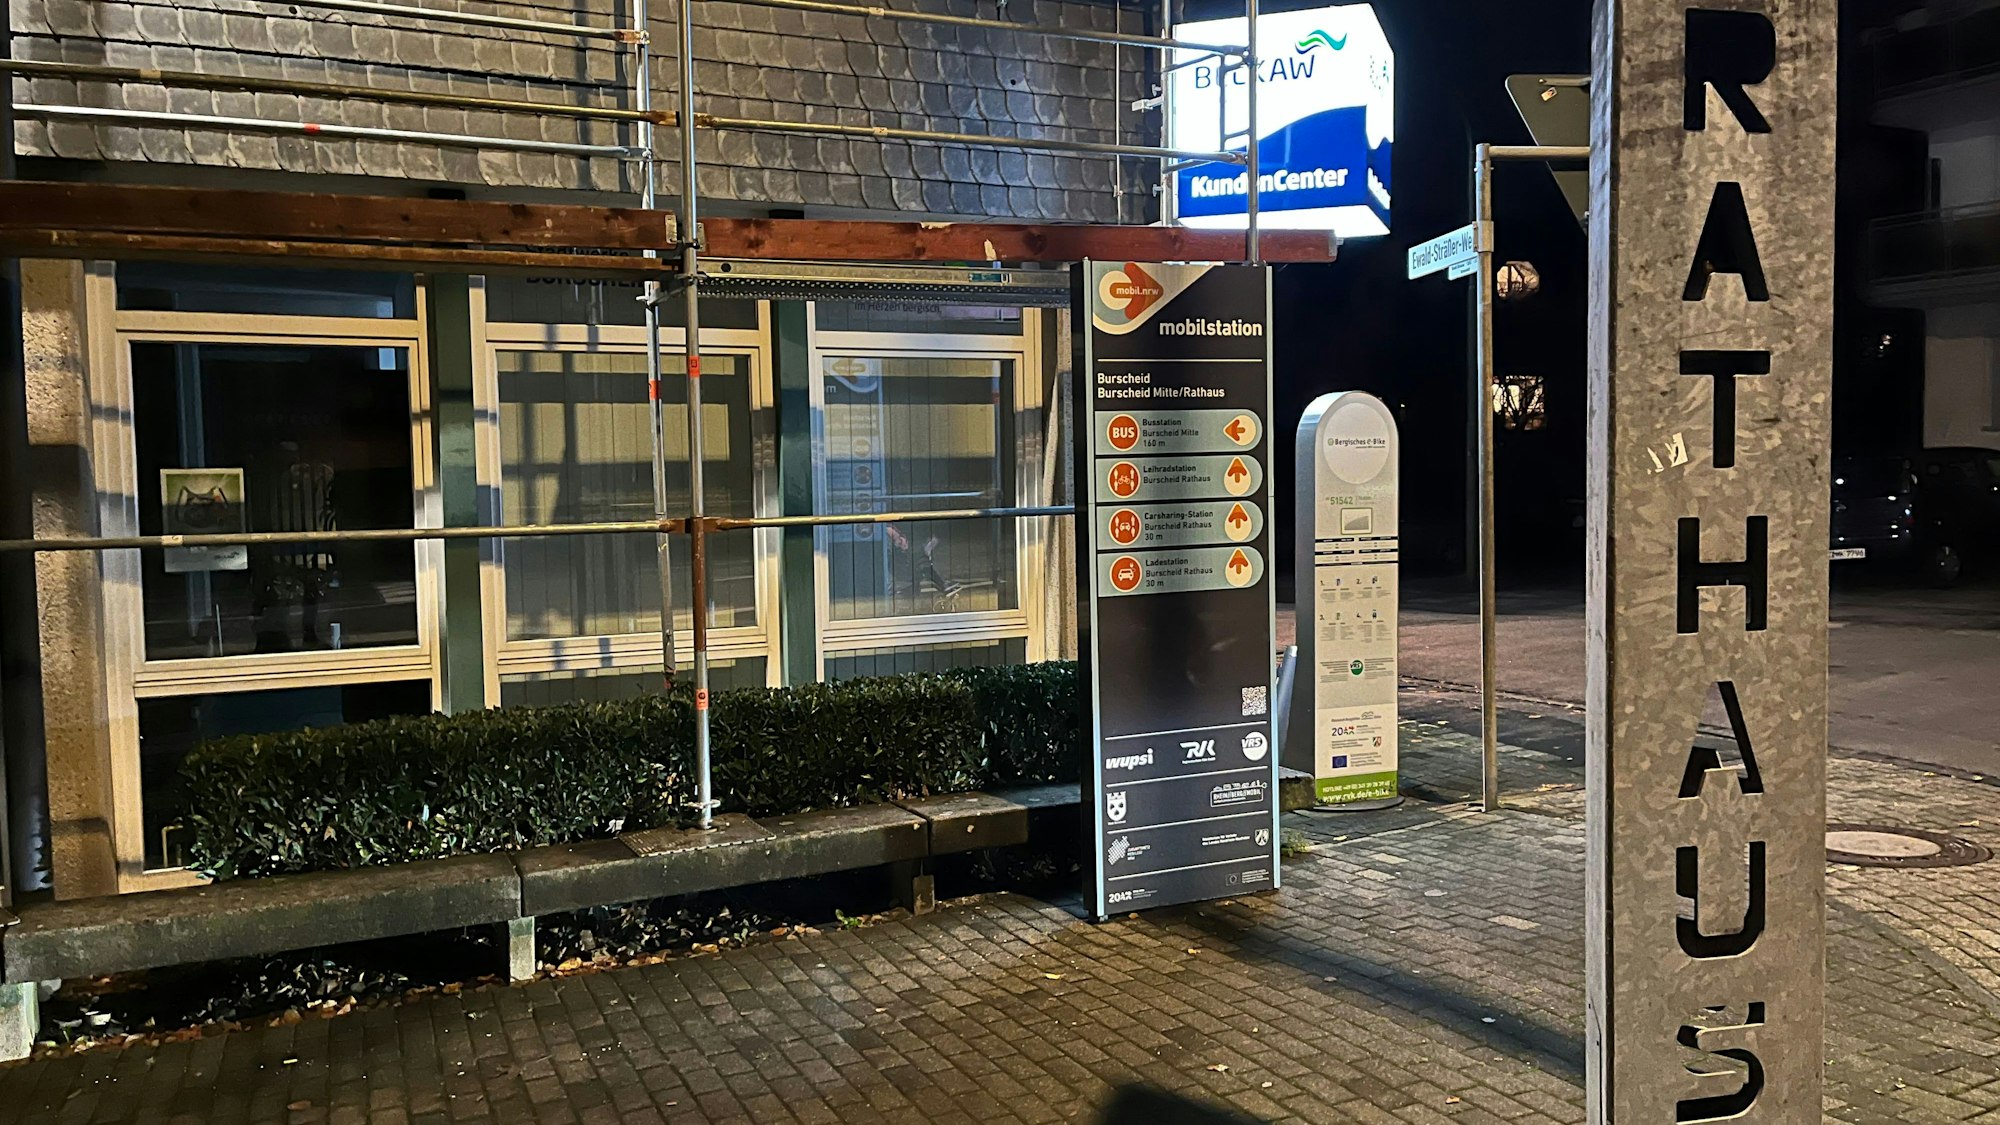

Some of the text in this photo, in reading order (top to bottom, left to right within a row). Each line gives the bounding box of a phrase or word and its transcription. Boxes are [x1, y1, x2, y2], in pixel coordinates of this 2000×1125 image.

[1191, 168, 1349, 198] KundnCenter
[1412, 232, 1473, 269] Ewald-Sträßer-We
[1116, 283, 1159, 296] mobil.nrw
[1159, 318, 1263, 336] mobilstation
[1097, 373, 1150, 384] Burscheid
[1097, 387, 1225, 398] Burscheid Mitte/Rathaus
[1112, 427, 1135, 438] BUS
[1335, 438, 1366, 446] Bergisches
[1143, 465, 1197, 473] Leihradstation
[1181, 475, 1211, 483] Rathaus
[1330, 497, 1353, 505] 51542
[1144, 510, 1214, 520] Carsharing-Station
[1144, 521, 1212, 531] Burscheid Rathaus
[1145, 557, 1189, 566] Ladestation
[1676, 7, 1777, 1124] RATHAUS
[1146, 566, 1213, 578] Burscheid Rathaus
[1146, 579, 1155, 587] 30
[1242, 737, 1263, 748] VRS
[1106, 748, 1154, 770] wupsi
